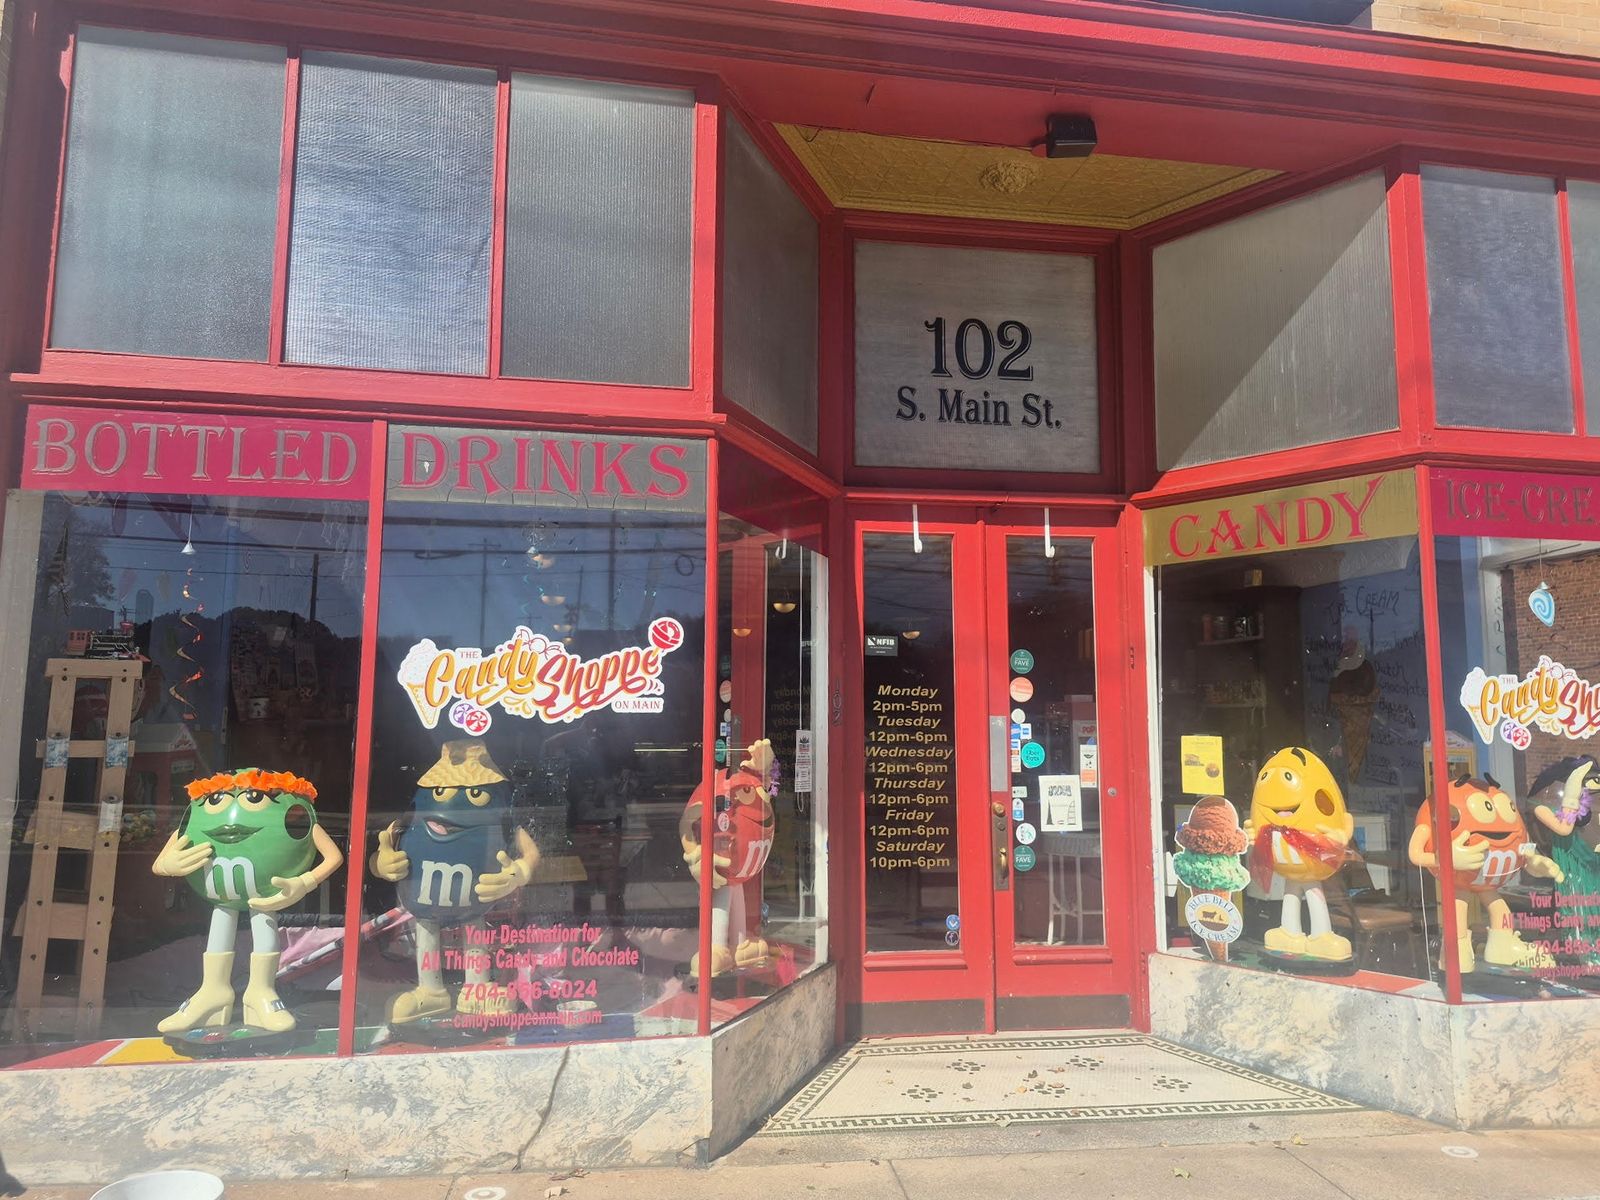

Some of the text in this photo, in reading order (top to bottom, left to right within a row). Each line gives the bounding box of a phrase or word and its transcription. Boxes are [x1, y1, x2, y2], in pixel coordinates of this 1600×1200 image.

[924, 316, 1034, 381] 102
[896, 385, 1062, 428] S. Main St.
[31, 418, 690, 500] BOTTLED DRINKS
[1169, 475, 1385, 559] CANDY
[876, 638, 895, 646] NFIB
[459, 650, 479, 659] THE
[1014, 659, 1030, 667] FAVE
[424, 638, 664, 719] Candy Shoppe
[877, 685, 939, 699] Monday
[1480, 665, 1559, 725] Candy
[614, 699, 661, 710] ON MAIN
[872, 700, 943, 714] 2pm-5pm
[877, 715, 941, 729] Tuesday
[868, 731, 948, 744] 12pm-6pm
[865, 746, 953, 760] Wednesday
[869, 762, 948, 775] 12pm-6pm
[874, 778, 946, 791] Thursday
[869, 793, 949, 807] 12pm-6pm
[885, 808, 935, 823] Friday
[869, 825, 950, 838] 12pm-6pm
[876, 840, 945, 854] Saturday
[869, 856, 951, 870] 10pm-6pm
[1015, 856, 1031, 864] FAVE
[417, 860, 473, 907] m
[1529, 891, 1552, 908] Your
[1516, 912, 1552, 932] Things
[466, 922, 602, 945] Your Destination for
[421, 946, 640, 973] All Things Candy and Chocolate
